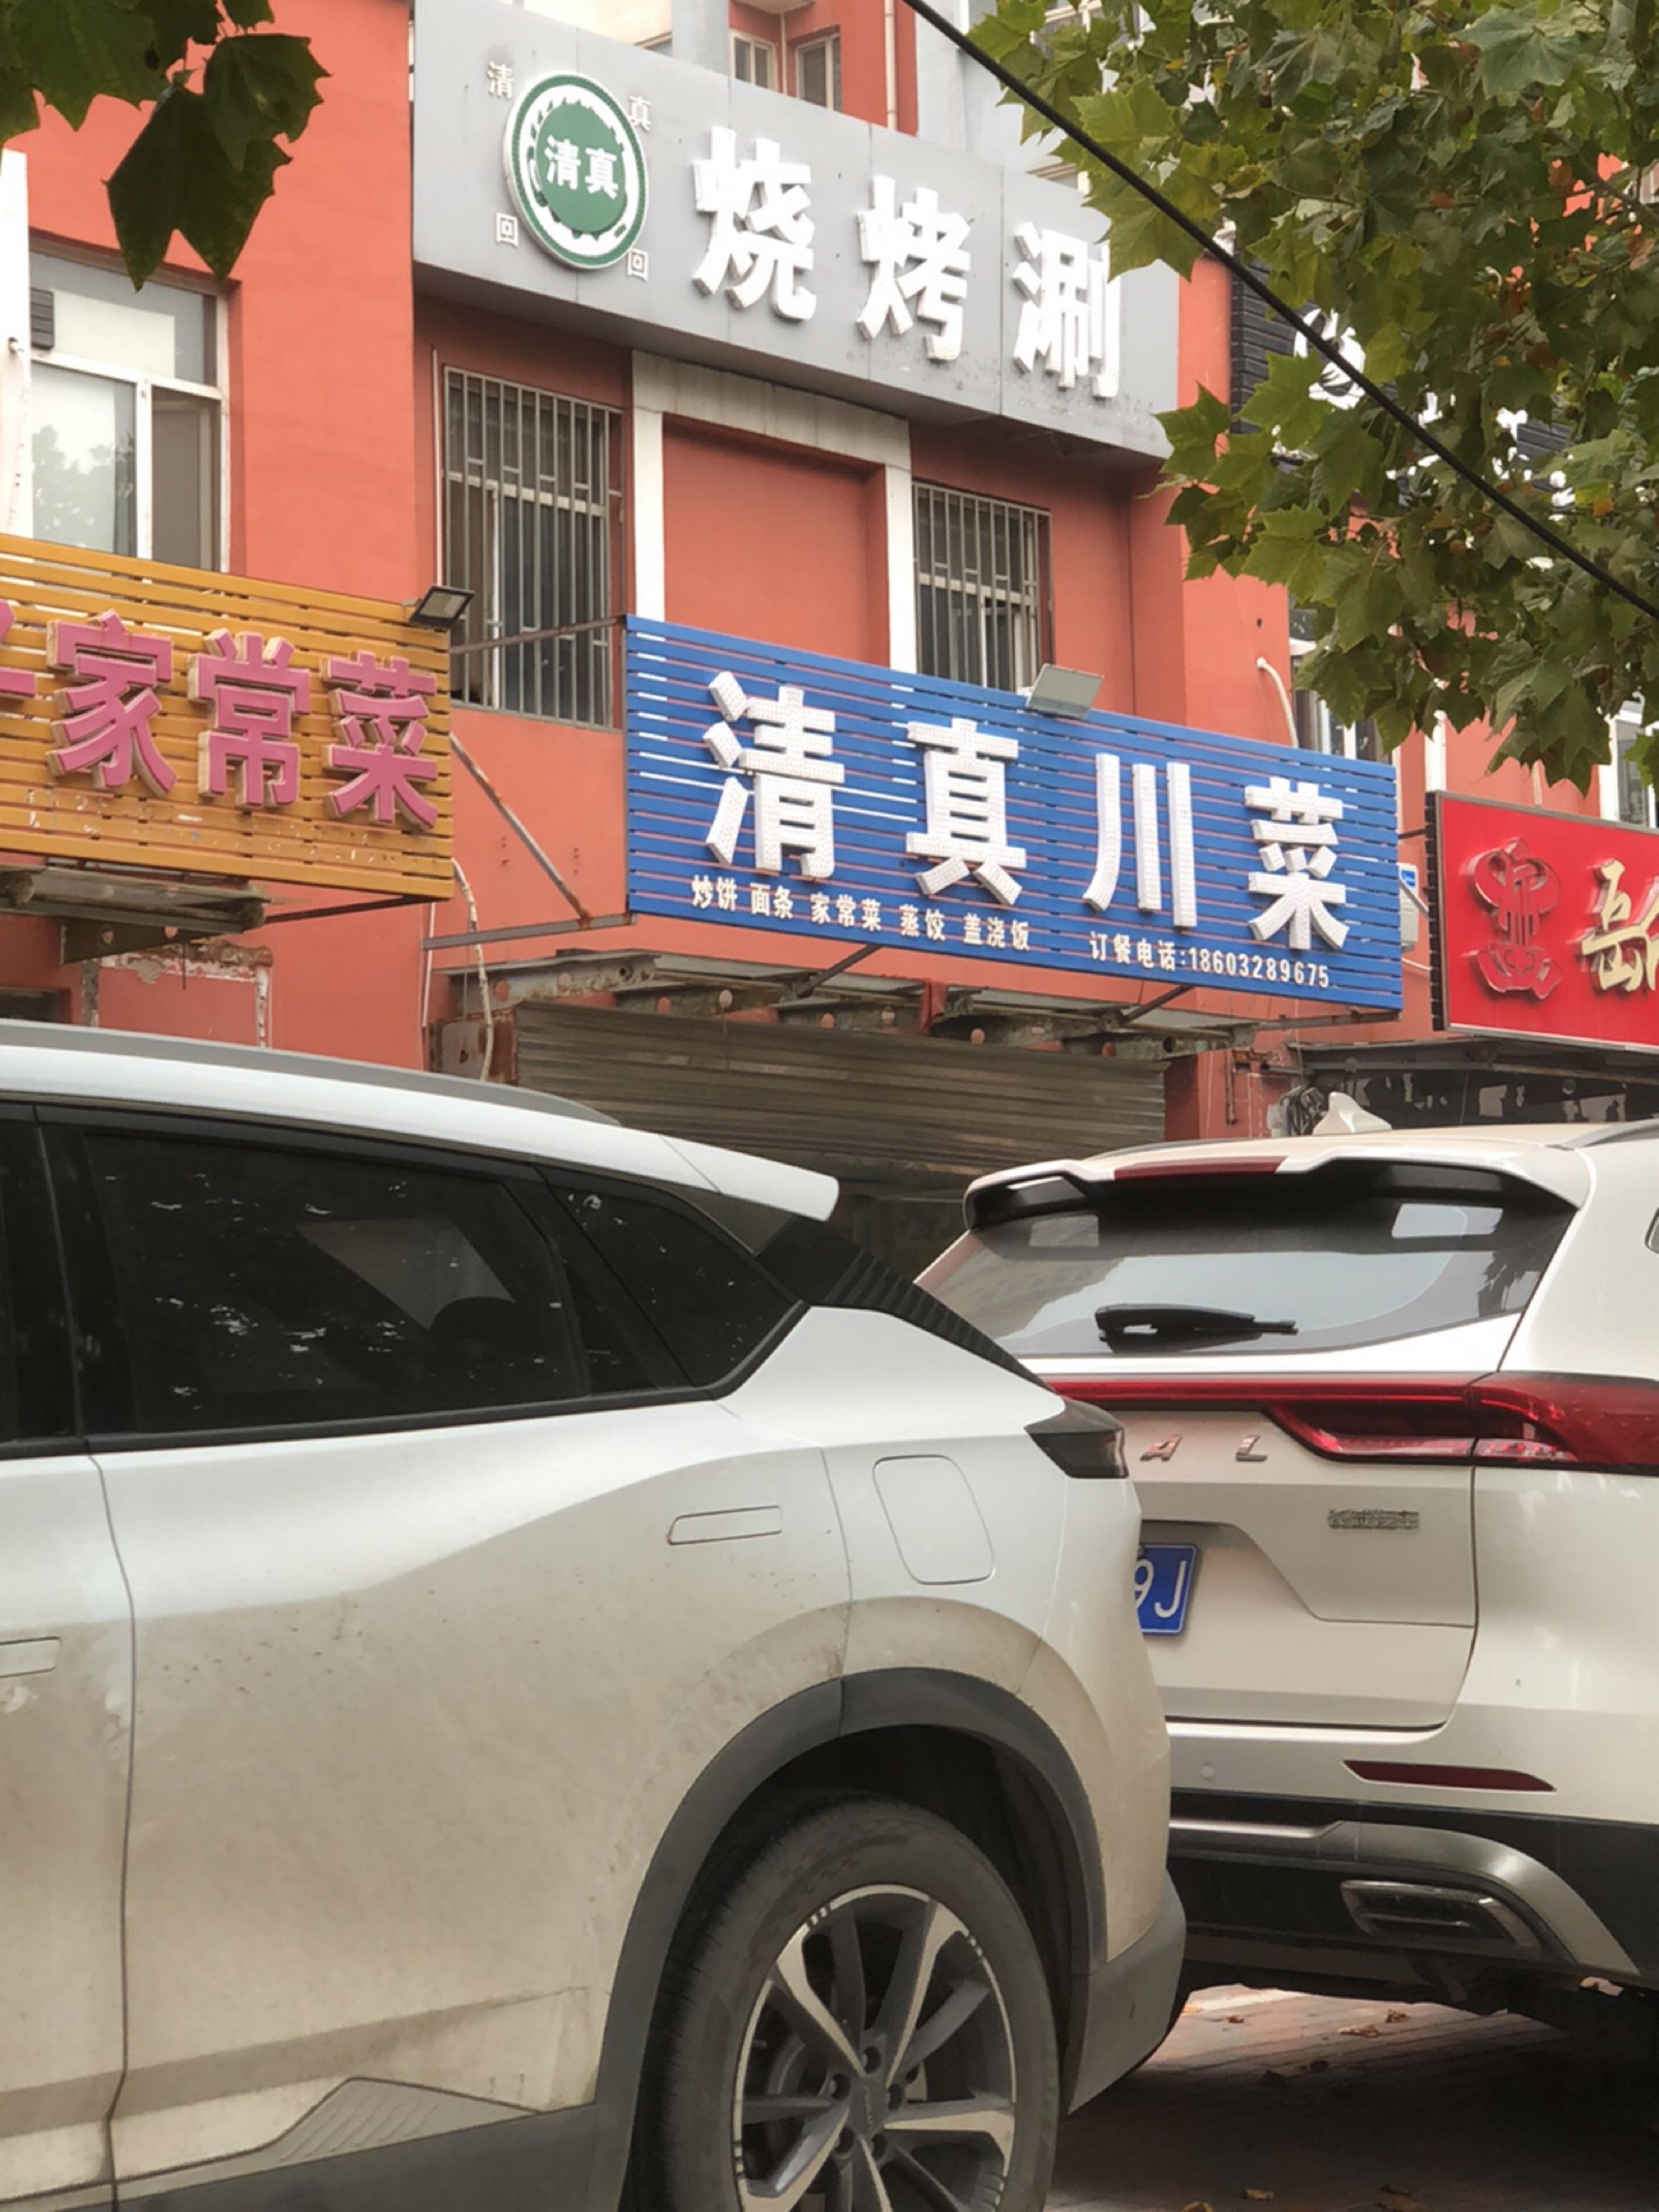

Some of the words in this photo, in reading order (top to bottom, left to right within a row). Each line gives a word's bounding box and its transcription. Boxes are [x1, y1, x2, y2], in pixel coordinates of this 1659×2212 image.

[487, 61, 514, 100] 清
[544, 134, 619, 200] 清真
[693, 126, 1121, 398] 烧烤涮
[703, 671, 1349, 950] 清真川菜
[691, 874, 738, 912] 炒饼
[749, 882, 794, 919] 面条
[810, 890, 882, 932] 家常菜
[898, 903, 945, 942] 蒸饺
[962, 912, 1030, 952] 盖浇饭
[1089, 931, 1331, 989] 订餐电话:18603289675
